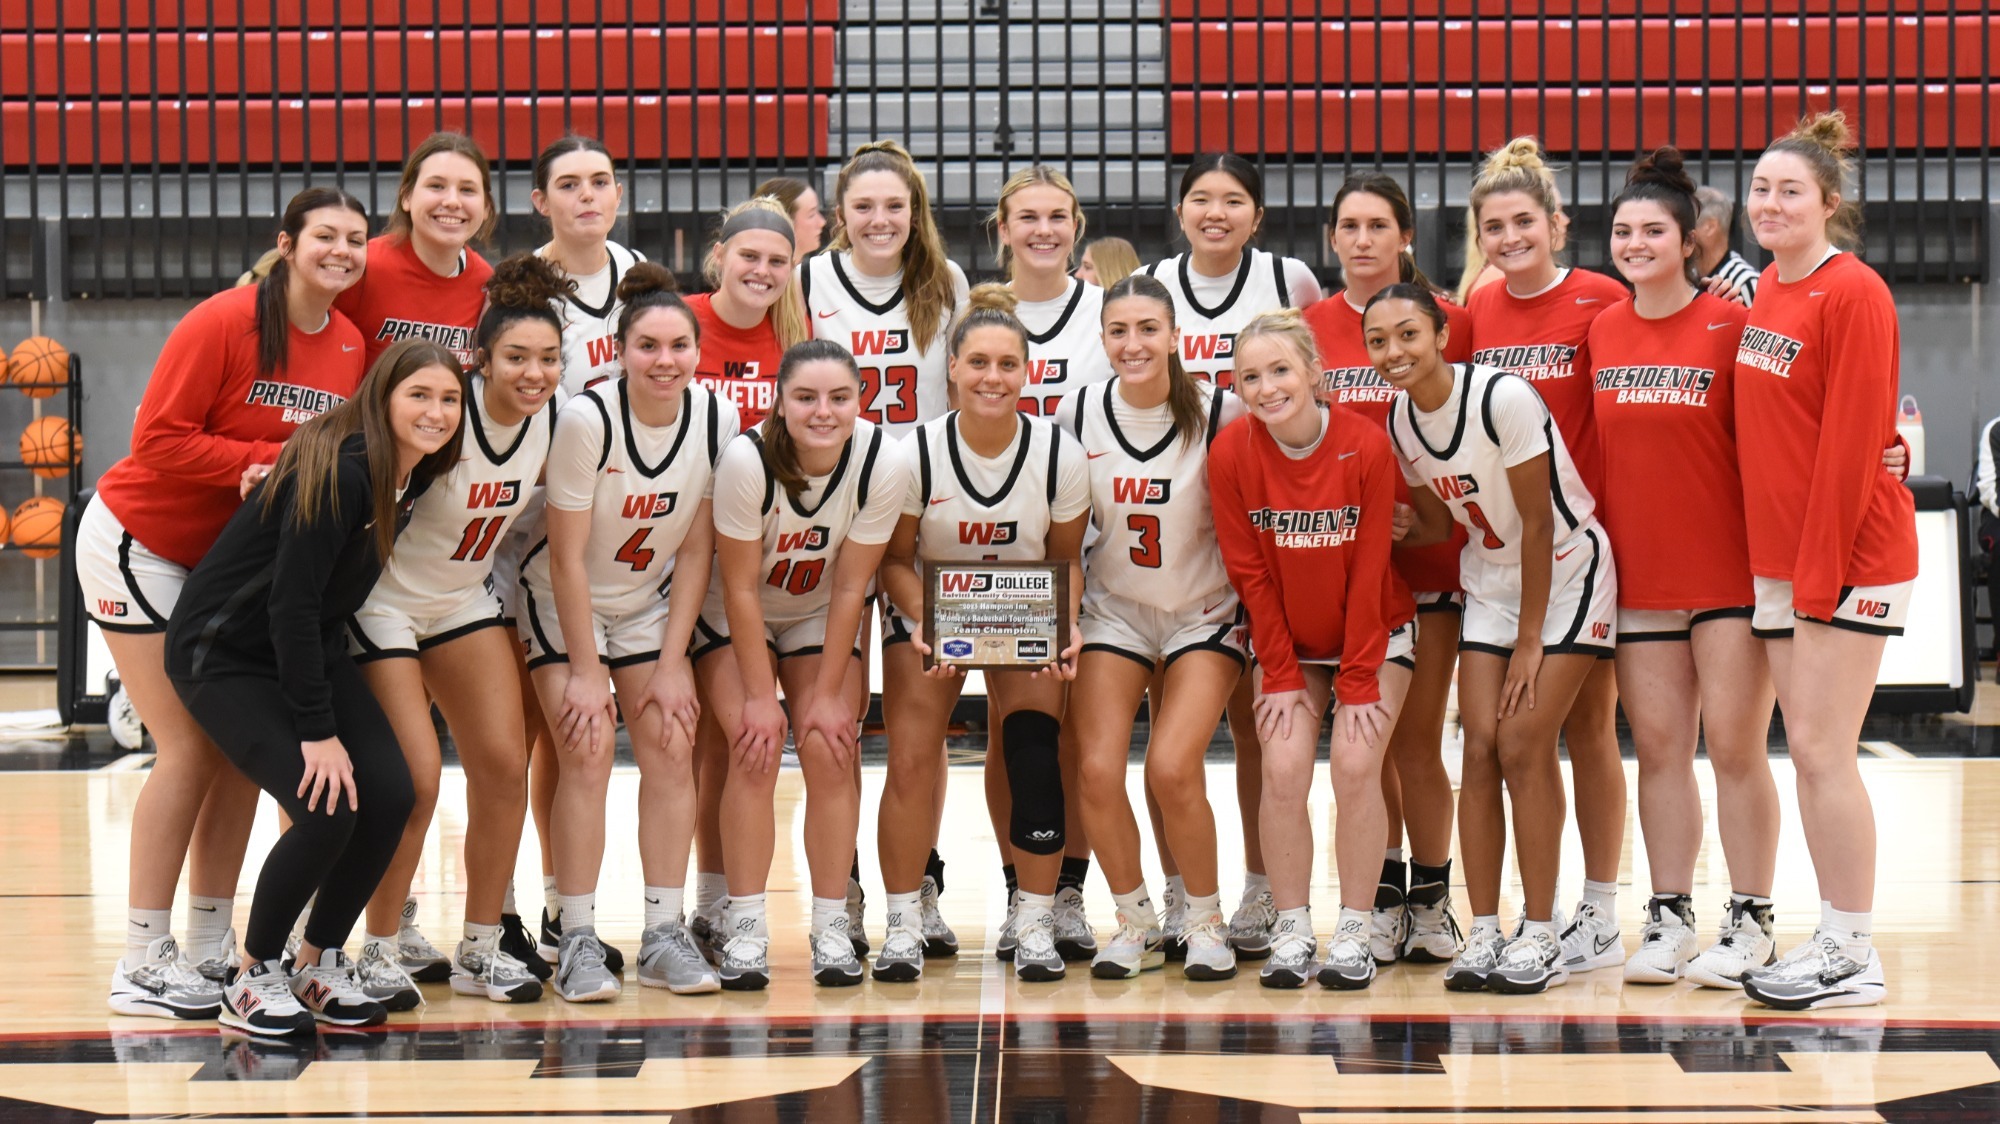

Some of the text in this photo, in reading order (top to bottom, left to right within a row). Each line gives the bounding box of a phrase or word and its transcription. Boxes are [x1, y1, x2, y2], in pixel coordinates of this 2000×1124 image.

[851, 329, 909, 356] W&J
[1184, 333, 1238, 360] W&J
[1738, 325, 1804, 364] SIDENTS
[1593, 365, 1715, 393] PRESIDENTS
[859, 365, 918, 425] 23
[1616, 389, 1707, 407] BASKETBALL
[467, 480, 521, 509] W&J
[1113, 477, 1171, 505] W&J
[1432, 473, 1479, 501] W&J
[621, 492, 678, 519] W&J
[450, 516, 507, 561] 11
[776, 525, 830, 553] W&J
[959, 521, 1018, 546] W&J
[1127, 513, 1162, 569] 3
[614, 527, 655, 571] 4
[766, 557, 826, 596] 10
[942, 573, 1049, 592] W&J COLLEGE
[940, 614, 1051, 622] Women's Basketball Tournament
[980, 603, 1014, 611] Hampton
[983, 626, 1037, 635] Champion
[234, 987, 261, 1018] N
[301, 978, 332, 1008] N
